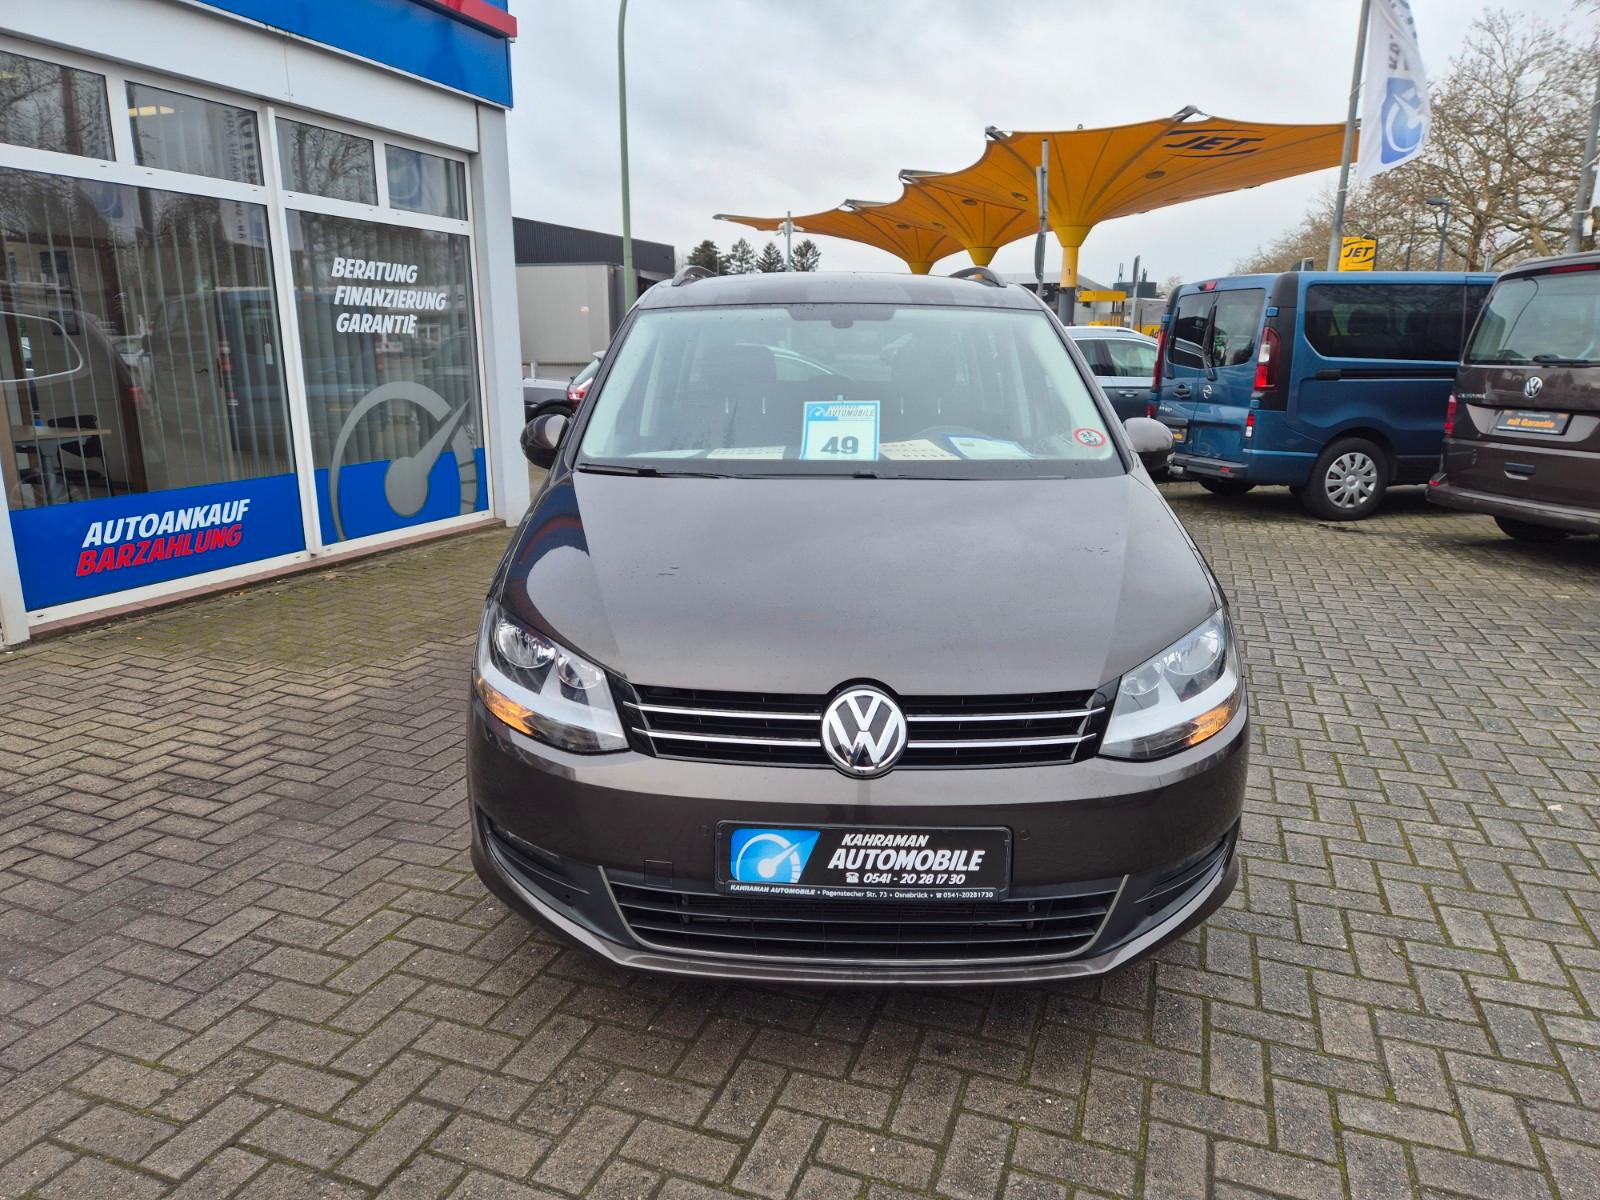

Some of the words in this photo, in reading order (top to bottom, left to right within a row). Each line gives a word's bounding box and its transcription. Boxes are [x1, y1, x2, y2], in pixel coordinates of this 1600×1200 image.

[1163, 135, 1265, 151] JET
[1344, 246, 1374, 258] JET
[331, 257, 418, 284] BERATUNG
[333, 285, 447, 311] FINANZIERUNG
[335, 313, 418, 335] GARANTIE
[827, 407, 874, 417] AUTOMOBILE
[820, 435, 860, 455] 49
[82, 498, 250, 548] AUTOANKAUF
[76, 524, 242, 576] BARZAHLUNG
[822, 688, 907, 773] VW
[841, 833, 930, 847] KAHRAMAN
[827, 848, 986, 872] AUTOMOBILE
[863, 872, 892, 884] 0541
[900, 874, 917, 884] 20
[918, 874, 935, 885] 28
[936, 874, 948, 885] 17
[948, 874, 966, 885] 30
[730, 884, 769, 893] KAHRAMAN
[770, 887, 816, 895] AUTOMOBILE
